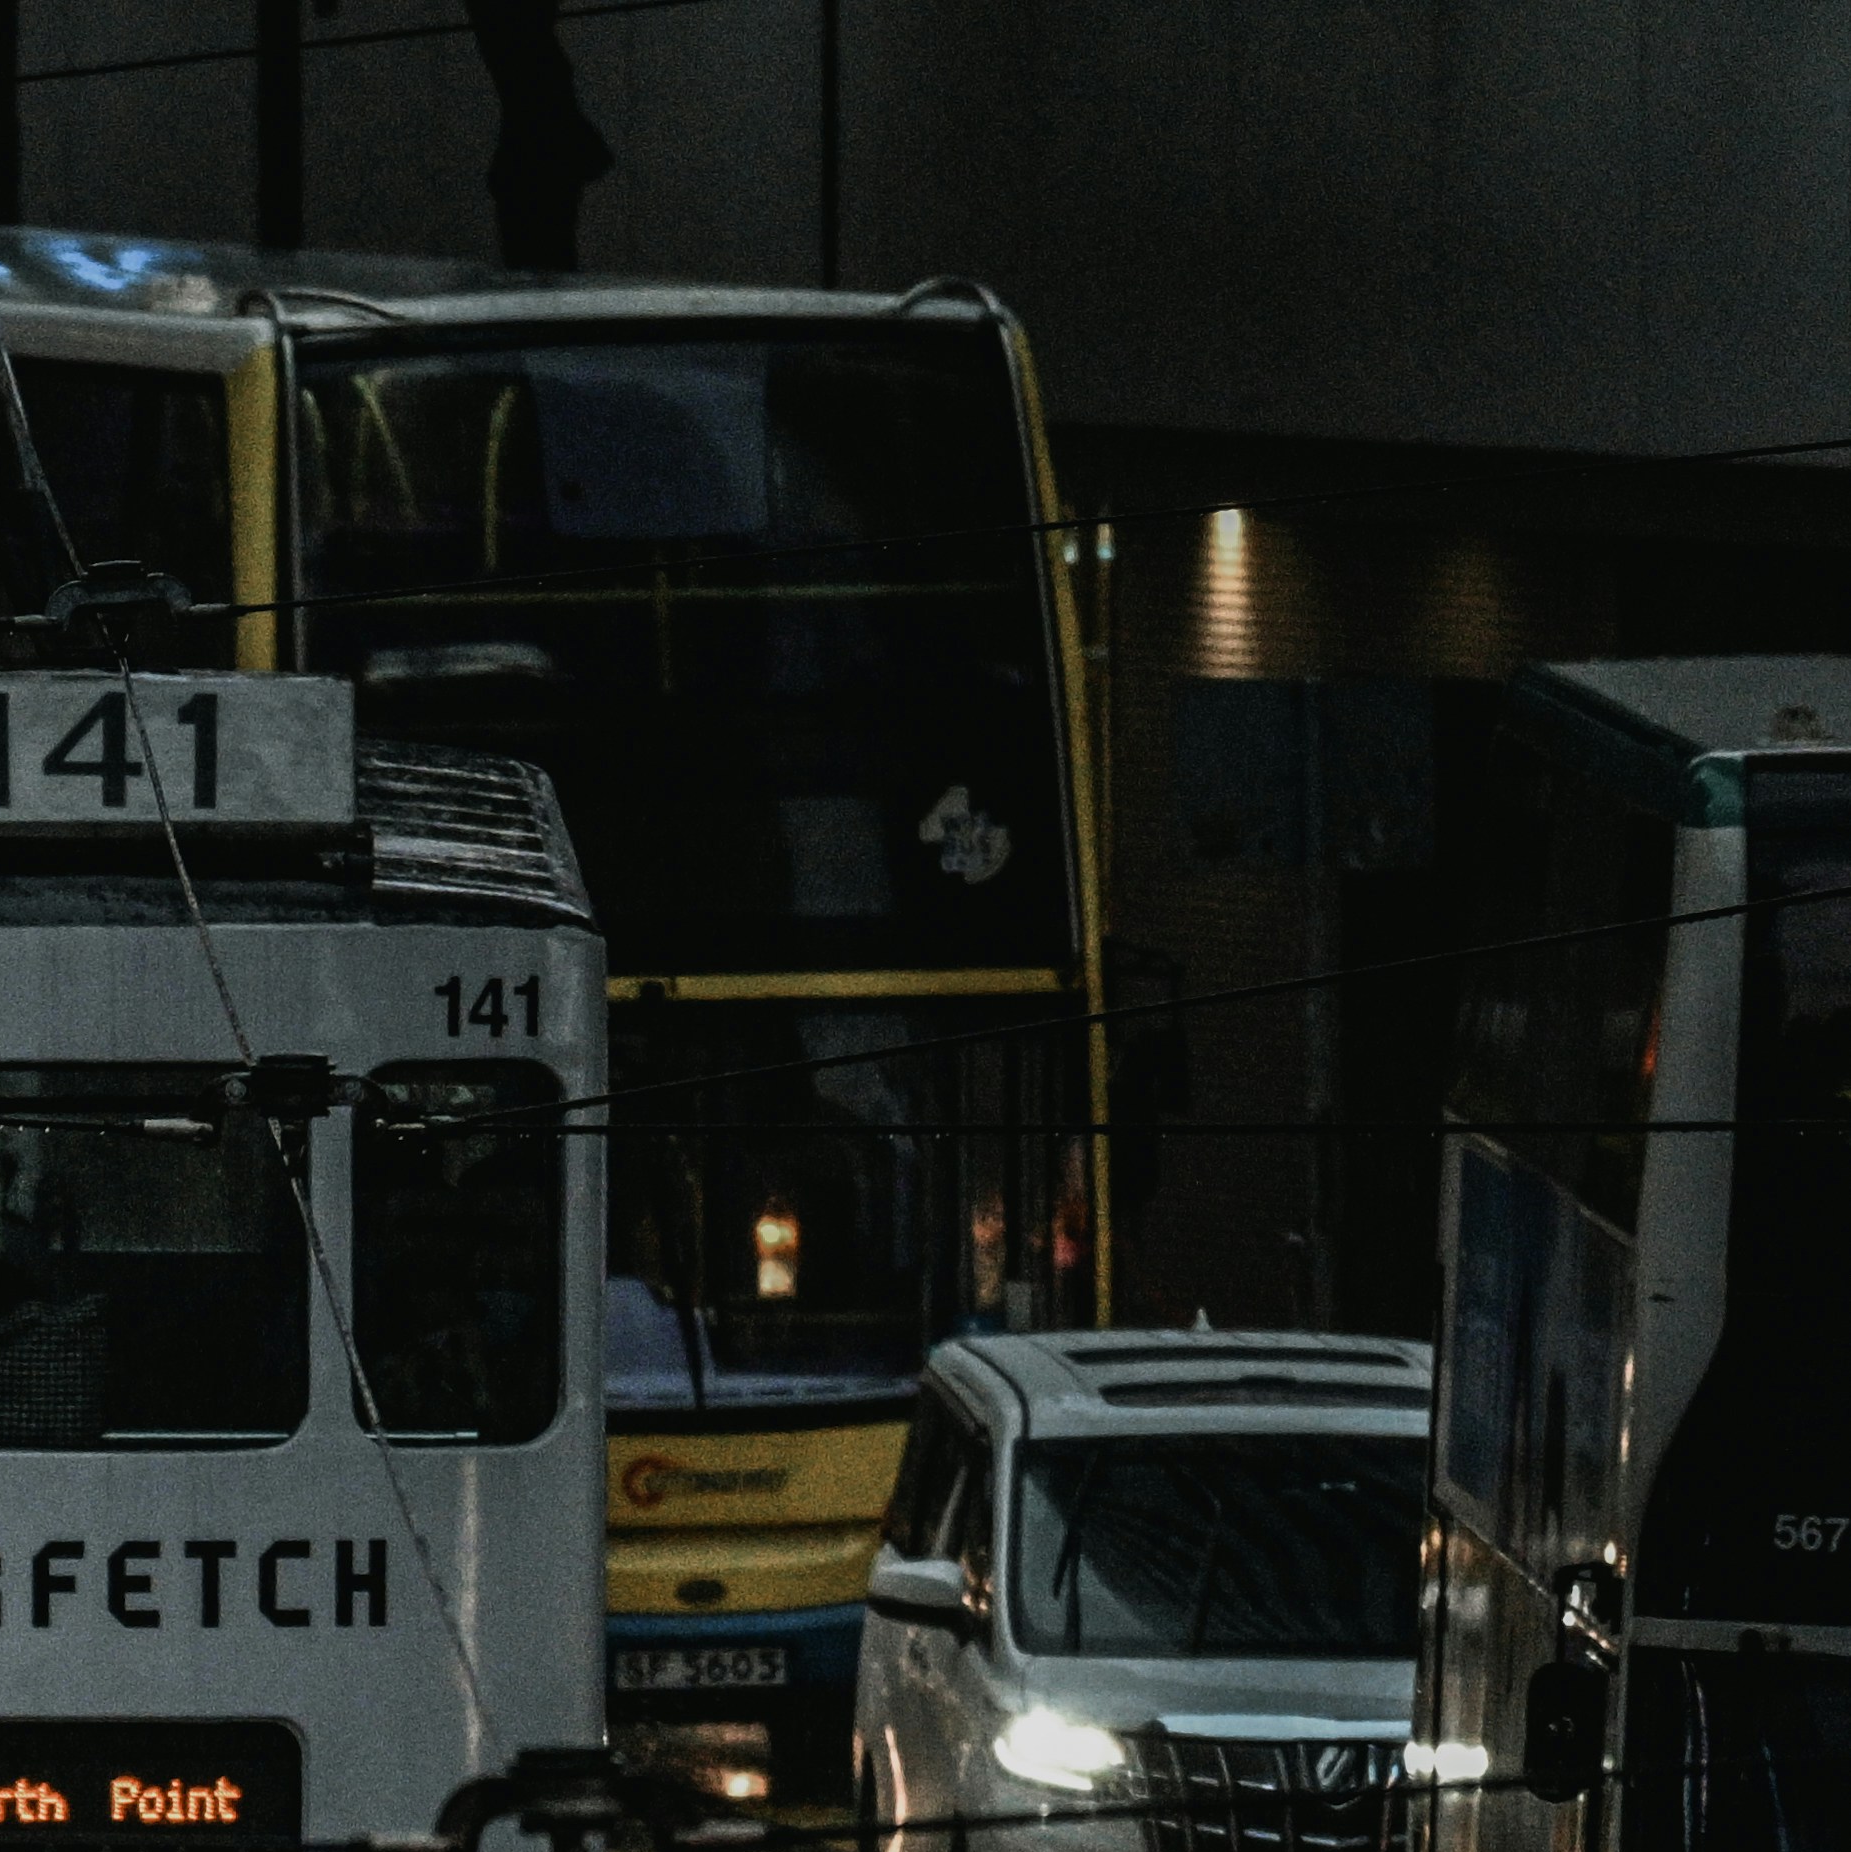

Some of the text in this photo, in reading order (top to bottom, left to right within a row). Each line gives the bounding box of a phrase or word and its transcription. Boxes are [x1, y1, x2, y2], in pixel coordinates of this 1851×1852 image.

[434, 976, 542, 1038] 141
[1773, 1513, 1851, 1553] 567
[110, 1777, 244, 1825] Point
